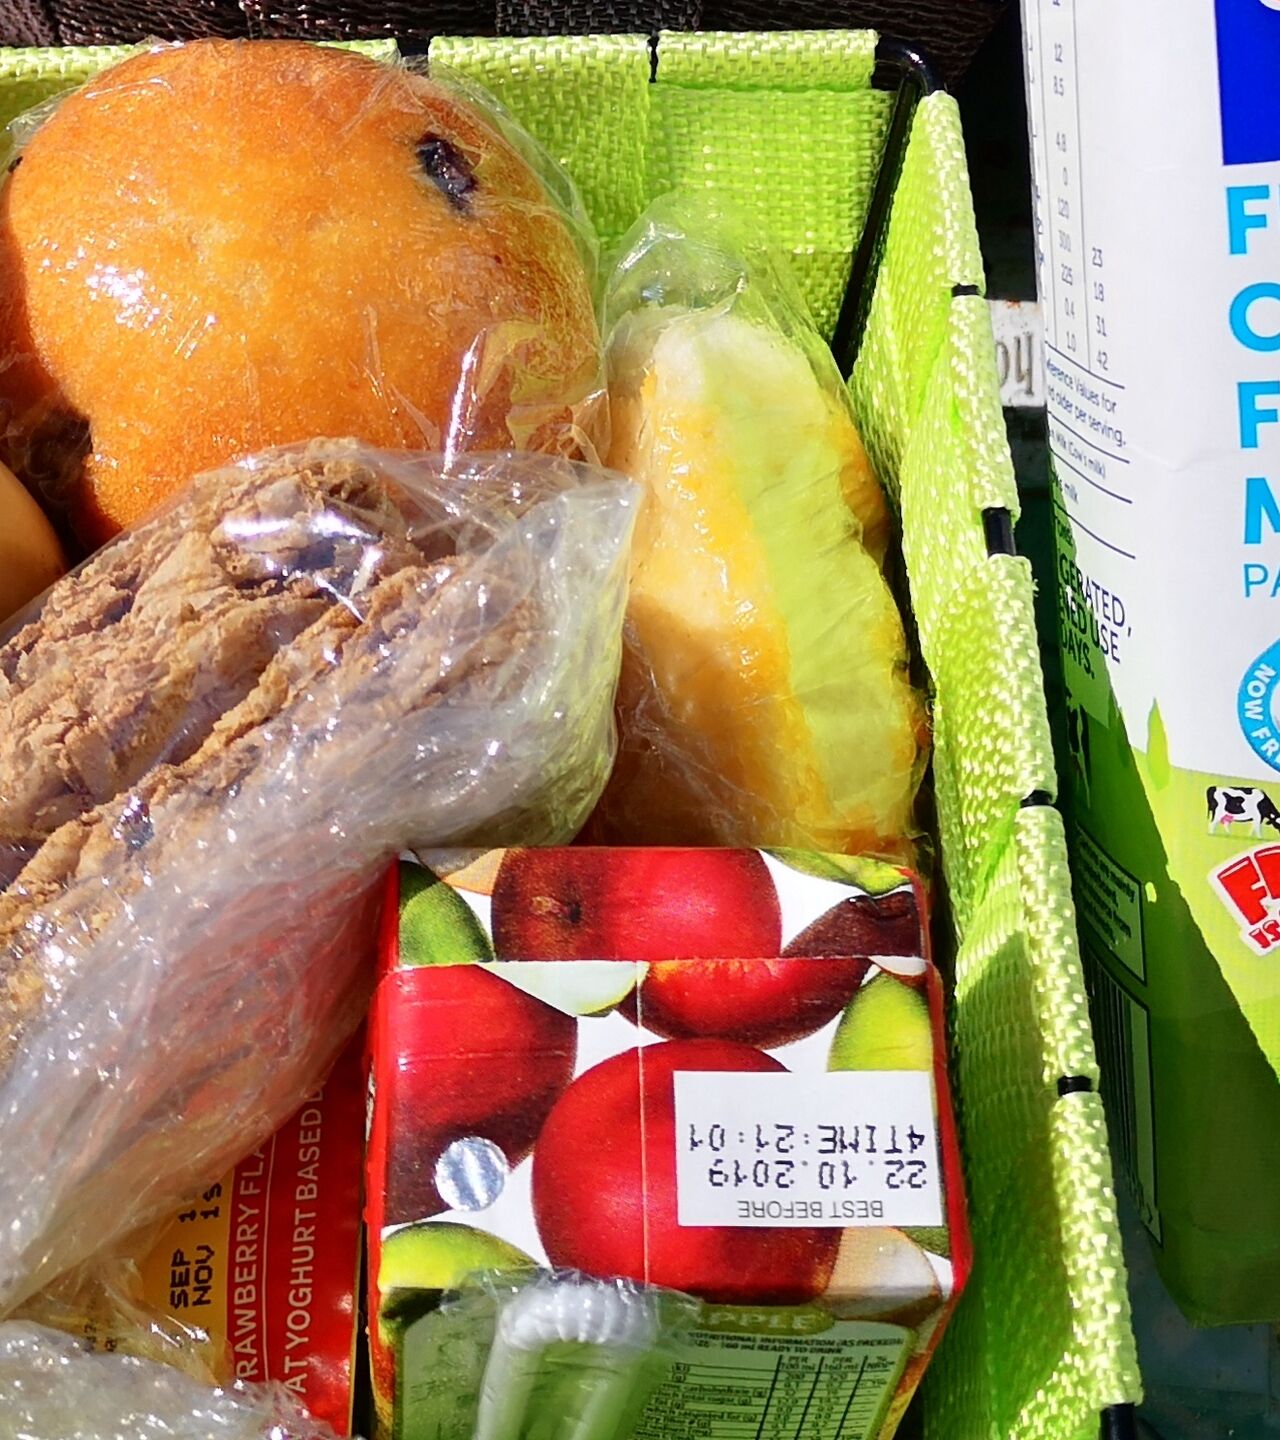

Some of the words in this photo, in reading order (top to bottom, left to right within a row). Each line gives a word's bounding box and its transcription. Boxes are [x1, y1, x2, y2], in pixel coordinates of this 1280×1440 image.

[1092, 247, 1103, 267] 23
[1093, 281, 1105, 302] 18
[1096, 315, 1107, 337] 31
[1096, 350, 1109, 371] 42
[1075, 378, 1100, 407] Values
[1101, 391, 1117, 413] for
[1088, 413, 1126, 447] serving.
[1090, 612, 1121, 665] USE
[1244, 664, 1277, 721] NOW
[296, 1108, 322, 1201] BASED
[689, 1123, 925, 1153] 4TIME:21:01
[737, 1200, 823, 1219] BEFORE
[832, 1200, 884, 1219] BEST
[170, 1248, 191, 1309] SEP
[192, 1244, 215, 1307] NOV
[234, 1202, 259, 1378] RAWBERRY
[285, 1207, 317, 1347] YOGHURT
[755, 1343, 792, 1354] READY
[793, 1345, 808, 1354] TO
[809, 1346, 843, 1355] DRINK
[760, 1336, 836, 1347] INFORMATION
[284, 1356, 308, 1394] AT
